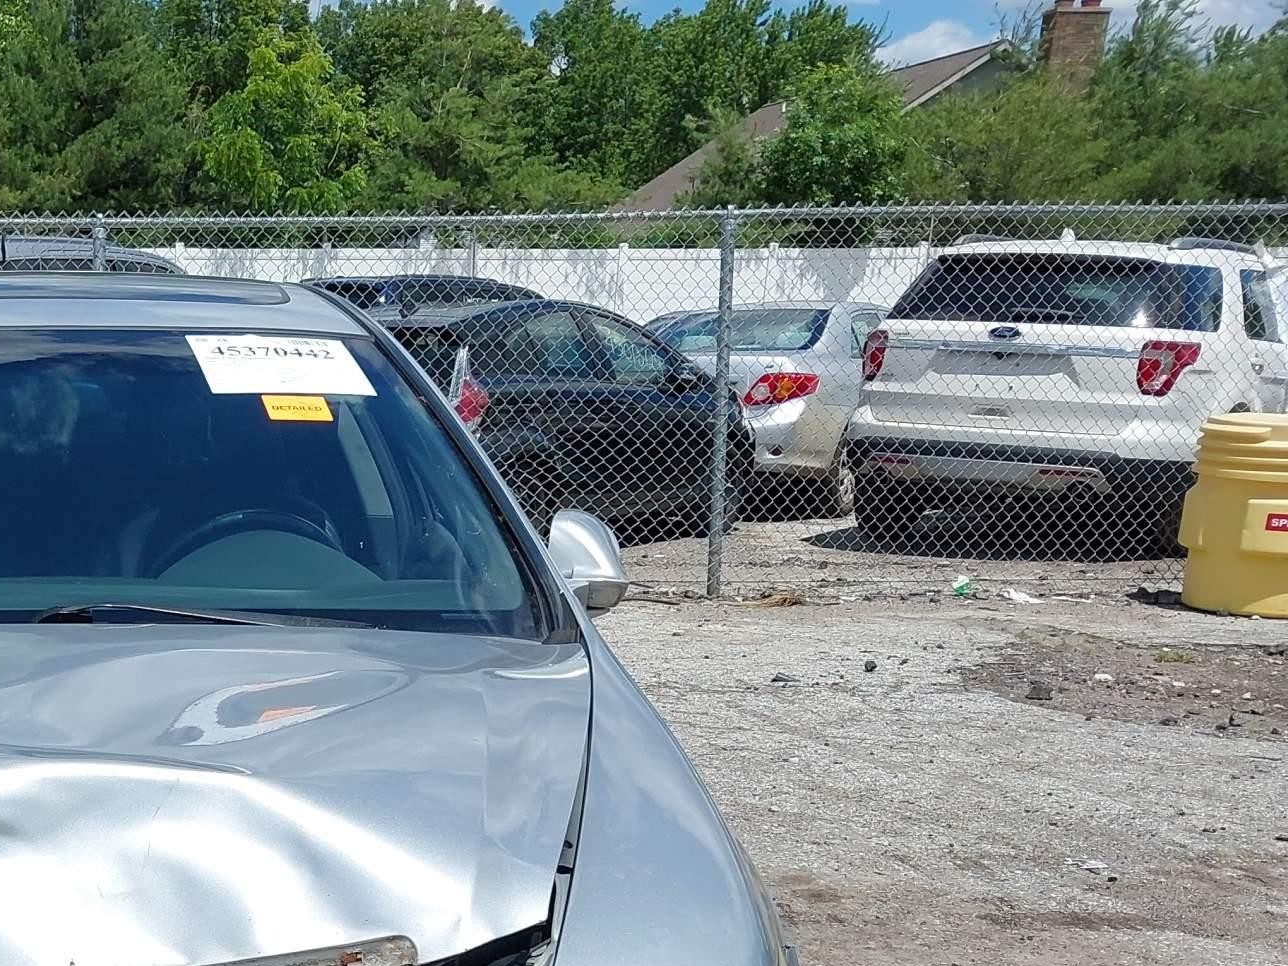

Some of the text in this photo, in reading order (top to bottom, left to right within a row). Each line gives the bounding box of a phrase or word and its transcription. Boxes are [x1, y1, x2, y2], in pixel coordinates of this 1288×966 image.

[210, 346, 335, 360] 45370442
[271, 405, 323, 413] DETAILED
[1271, 518, 1288, 528] SP
